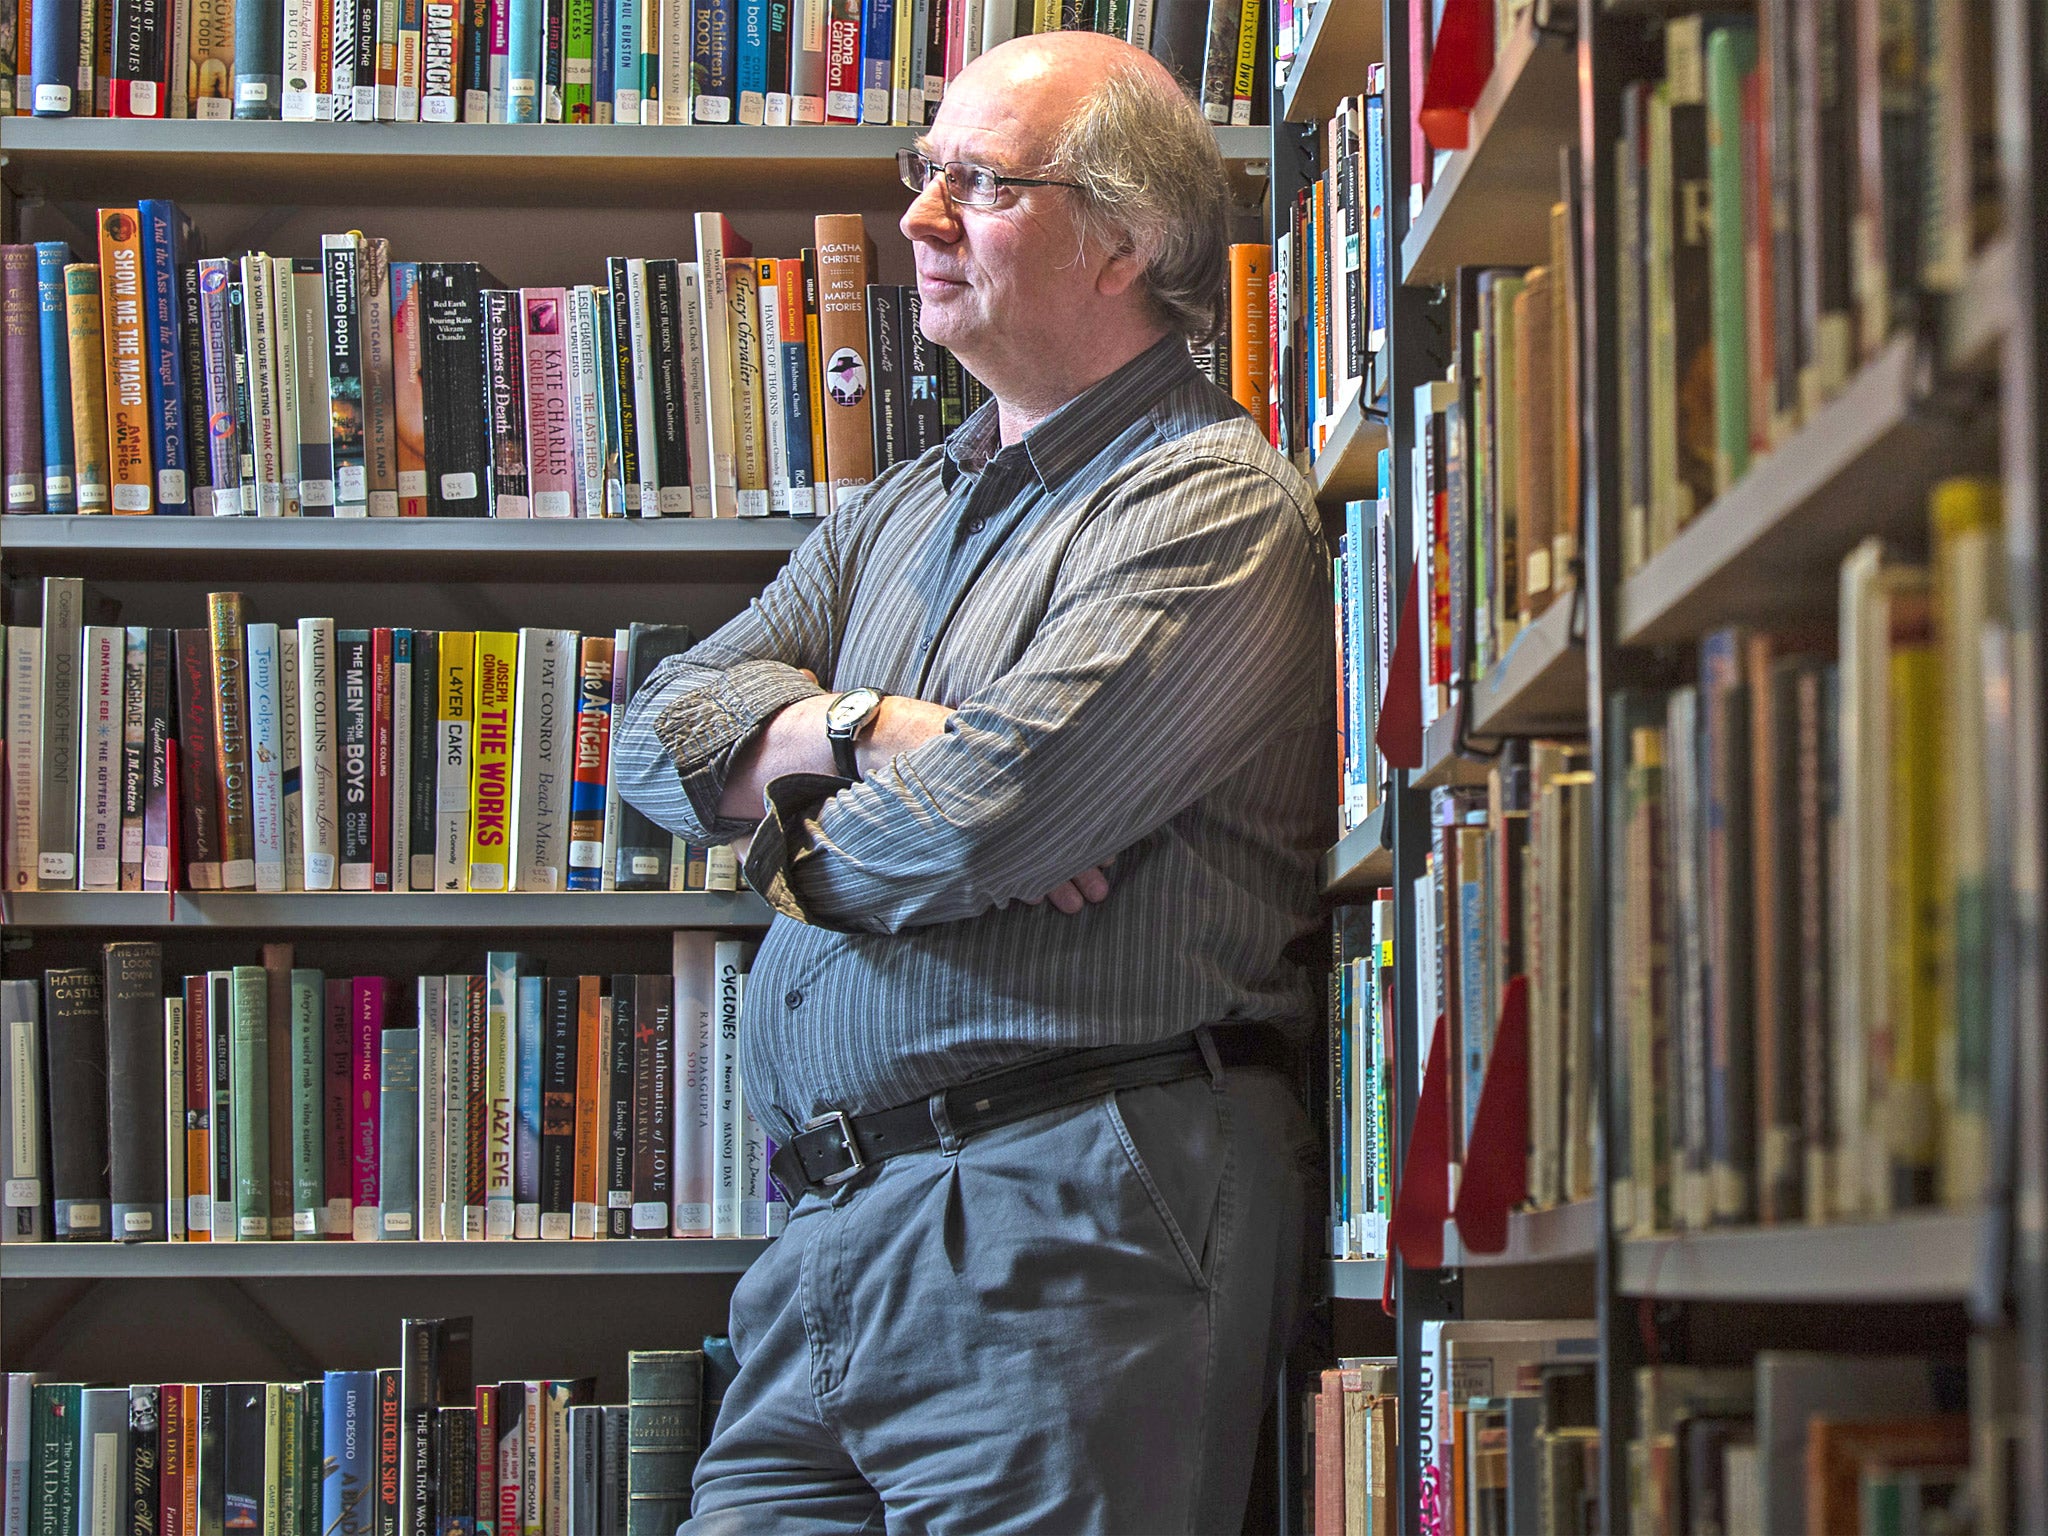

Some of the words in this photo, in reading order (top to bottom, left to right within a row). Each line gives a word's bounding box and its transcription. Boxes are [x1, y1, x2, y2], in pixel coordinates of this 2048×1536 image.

[362, 8, 371, 32] sean
[496, 20, 505, 48] rush
[550, 17, 560, 49] alma
[697, 10, 710, 56] BOOK
[747, 6, 760, 46] boat?
[772, 3, 785, 32] Cain
[1242, 1, 1259, 59] brixton
[129, 16, 140, 73] STORIES
[198, 19, 210, 56] CODE
[288, 10, 298, 71] BUCHAN
[301, 41, 311, 71] Woman
[321, 27, 331, 48] GOES
[322, 51, 331, 60] TO
[361, 36, 372, 66] burke
[404, 37, 414, 73] GORDON
[622, 25, 631, 68] BURSTON
[712, 10, 726, 87] Children's
[830, 21, 844, 86] cameron
[842, 22, 857, 64] rhona
[1236, 63, 1255, 96] bwoy
[154, 218, 167, 244] And
[821, 244, 862, 252] AGATHA
[114, 250, 137, 294] SHOW
[156, 248, 168, 266] the
[822, 254, 861, 263] CHRISTIE
[157, 272, 169, 293] Ass
[254, 285, 264, 310] YOUR
[334, 251, 348, 313] Fortune
[730, 276, 754, 318] Tracy
[825, 291, 861, 300] MARPLE
[832, 280, 854, 289] MISS
[116, 300, 137, 325] ME
[157, 298, 169, 322] saw
[429, 317, 452, 325] Pouring
[448, 300, 466, 308] Earth
[492, 296, 506, 325] The
[578, 291, 590, 318] LESLIE
[825, 303, 862, 312] STORIES
[160, 326, 172, 344] the
[256, 313, 266, 334] TIME
[334, 315, 349, 357] Hotel
[439, 325, 463, 333] Vikram
[764, 305, 776, 353] HARVEST
[117, 330, 139, 363] THE
[208, 302, 229, 403] shenanigans
[258, 337, 268, 370] YOU'RE
[493, 328, 506, 371] Snares
[579, 322, 592, 374] CHARTERIS
[737, 322, 758, 387] Chevalier
[768, 354, 777, 370] OF
[119, 366, 142, 406] MAGIC
[159, 349, 176, 387] Angel
[234, 354, 245, 384] Mama
[494, 375, 508, 392] of
[528, 350, 544, 388] CRUEL
[544, 350, 563, 391] KATE
[259, 373, 270, 415] WASTING
[584, 392, 594, 412] THE
[769, 372, 779, 416] THORNS
[163, 399, 178, 430] Nick
[495, 394, 509, 434] Death
[585, 416, 596, 444] LAST
[743, 390, 752, 442] BURNING
[165, 435, 179, 466] Cave
[262, 418, 273, 450] FRANK
[531, 392, 548, 474] HABITATIONS
[547, 398, 567, 476] CHARLES
[587, 447, 598, 478] HERO
[745, 445, 755, 487] BRIGHT
[255, 650, 272, 689] Jenny
[284, 642, 295, 672] NO
[313, 629, 326, 687] PAULINE
[352, 645, 363, 667] THE
[542, 658, 555, 689] PAT
[584, 660, 611, 689] the
[127, 669, 142, 727] DISGRACE
[347, 670, 363, 711] MEN
[449, 666, 463, 716] L4YER
[483, 653, 496, 708] CONNOLLY
[497, 660, 509, 702] JOSEPH
[152, 718, 164, 754] Elizabeth
[257, 695, 273, 742] Colgan
[285, 680, 297, 760] SMOKE
[314, 691, 327, 752] COLLINS
[346, 726, 355, 743] THE
[355, 712, 364, 739] FROM
[481, 709, 508, 754] THE
[539, 693, 554, 762] CONROY
[578, 692, 609, 768] African
[152, 756, 164, 787] Costello
[347, 745, 365, 802] BOYS
[224, 761, 244, 824] FOWL
[478, 762, 506, 846] WORKS
[538, 773, 554, 817] Beach
[346, 812, 356, 856] COLLINS
[358, 812, 367, 845] PHILIP
[536, 822, 552, 867] Music
[363, 990, 372, 1020] ALAN
[555, 990, 567, 1037] BITTER
[656, 1005, 668, 1031] The
[721, 964, 736, 1040] CYCLONES
[699, 1011, 709, 1049] RANA
[362, 1026, 372, 1080] CUMMING
[554, 1045, 566, 1085] FRUIT
[639, 1048, 650, 1089] EMMA
[687, 1051, 696, 1089] SOLO
[655, 1038, 669, 1123] Mathematics
[699, 1056, 709, 1129] DASGUPTA
[724, 1066, 732, 1093] Novel
[493, 1098, 510, 1145] LAZY
[722, 1100, 732, 1111] by
[638, 1097, 650, 1154] DARWIN
[654, 1130, 666, 1142] of
[723, 1122, 733, 1159] MANOJ
[492, 1152, 509, 1187] EYE
[653, 1149, 666, 1191] LOVE
[723, 1166, 732, 1187] DAS
[346, 1390, 355, 1417] LEWIS
[386, 1376, 395, 1398] The
[168, 1396, 177, 1434] ANITA
[383, 1400, 396, 1464] BUTCHER
[417, 1412, 427, 1434] THE
[528, 1405, 536, 1433] BEND
[167, 1439, 176, 1475] DESAI
[346, 1420, 355, 1459] DESOTO
[417, 1437, 427, 1471] JEWEL
[480, 1428, 492, 1466] BINDI
[528, 1435, 535, 1444] IT
[528, 1446, 536, 1467] LIKE
[382, 1467, 396, 1504] SHOP
[417, 1472, 426, 1500] THAT
[480, 1471, 492, 1516] BABES
[528, 1470, 536, 1520] BECKHAM
[417, 1505, 426, 1527] WAS
